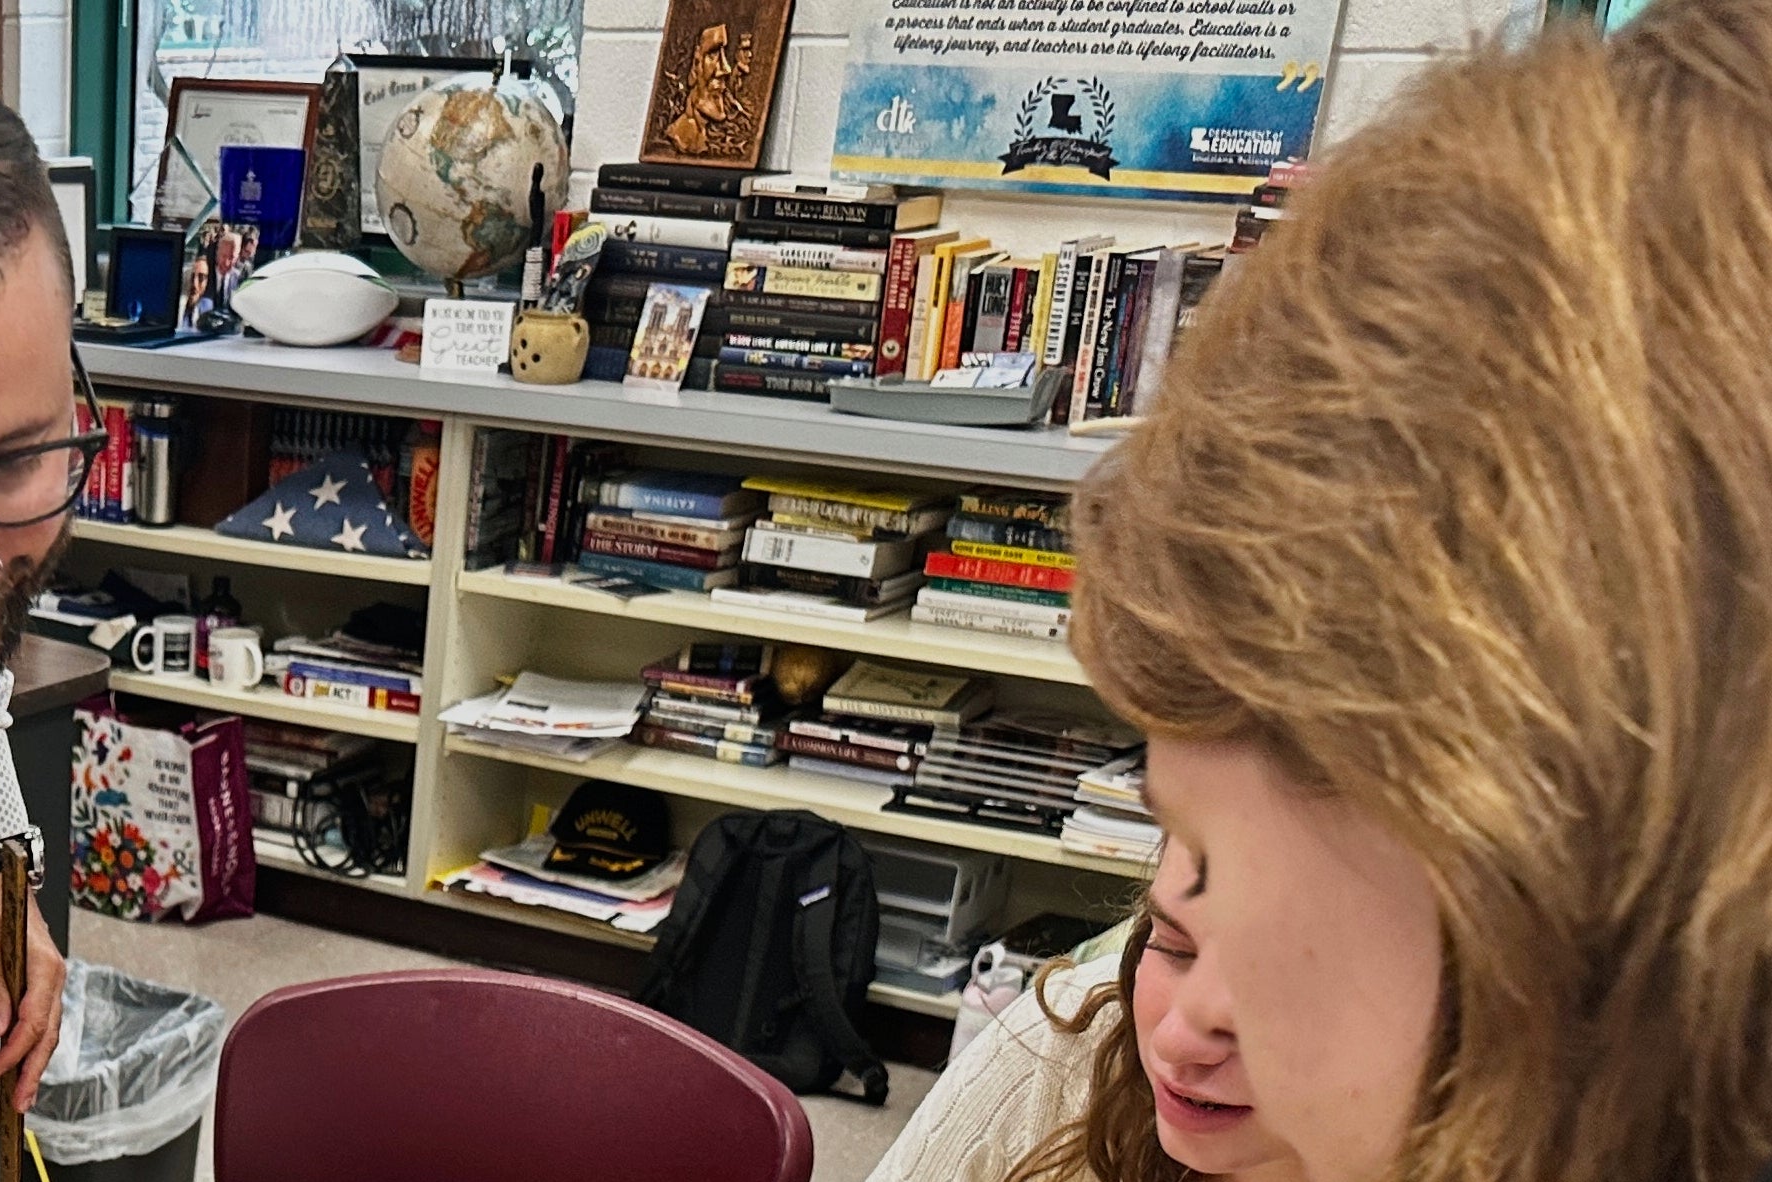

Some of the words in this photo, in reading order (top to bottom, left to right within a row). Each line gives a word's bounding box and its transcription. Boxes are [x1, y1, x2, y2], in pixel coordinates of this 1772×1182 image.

[998, 0, 1016, 10] an
[1070, 0, 1085, 11] to
[1087, 0, 1104, 12] be
[1106, 0, 1168, 18] confined
[1169, 1, 1184, 13] to
[1186, 0, 1236, 15] school
[1236, 0, 1276, 15] walls
[1278, 3, 1297, 16] or
[884, 18, 896, 29] a
[894, 17, 945, 32] process
[946, 16, 975, 31] that
[975, 17, 1006, 32] ends
[1008, 17, 1045, 32] when
[1047, 21, 1058, 33] a
[1059, 18, 1111, 34] student
[1111, 19, 1185, 39] graduates.
[1188, 18, 1262, 38] Education
[1264, 21, 1278, 38] is
[1280, 26, 1292, 38] a
[893, 34, 944, 55] lifelong
[941, 37, 1000, 57] journey,
[1003, 38, 1032, 53] and
[1031, 38, 1089, 55] teachers
[1090, 42, 1115, 56] are
[1116, 41, 1134, 56] its
[1135, 40, 1192, 62] lifelong
[1190, 41, 1276, 62] facilitators.
[1208, 128, 1273, 140] DEPARTMENT
[1211, 138, 1283, 156] EDUCATION
[774, 200, 801, 214] RACE
[822, 202, 868, 218] REUNION
[1054, 263, 1070, 304] SECOND
[1104, 296, 1117, 320] The
[1045, 307, 1064, 360] FOUNDING
[1099, 320, 1114, 347] New
[455, 354, 501, 367] TEACHER
[1095, 345, 1110, 368] Jim
[1091, 368, 1107, 400] Crow
[643, 493, 697, 512] KATRINA
[589, 537, 613, 555] THE
[614, 539, 659, 560] STORM
[839, 700, 860, 712] THE
[867, 703, 927, 719] ODYSSEY
[575, 808, 641, 842] UNWELL
